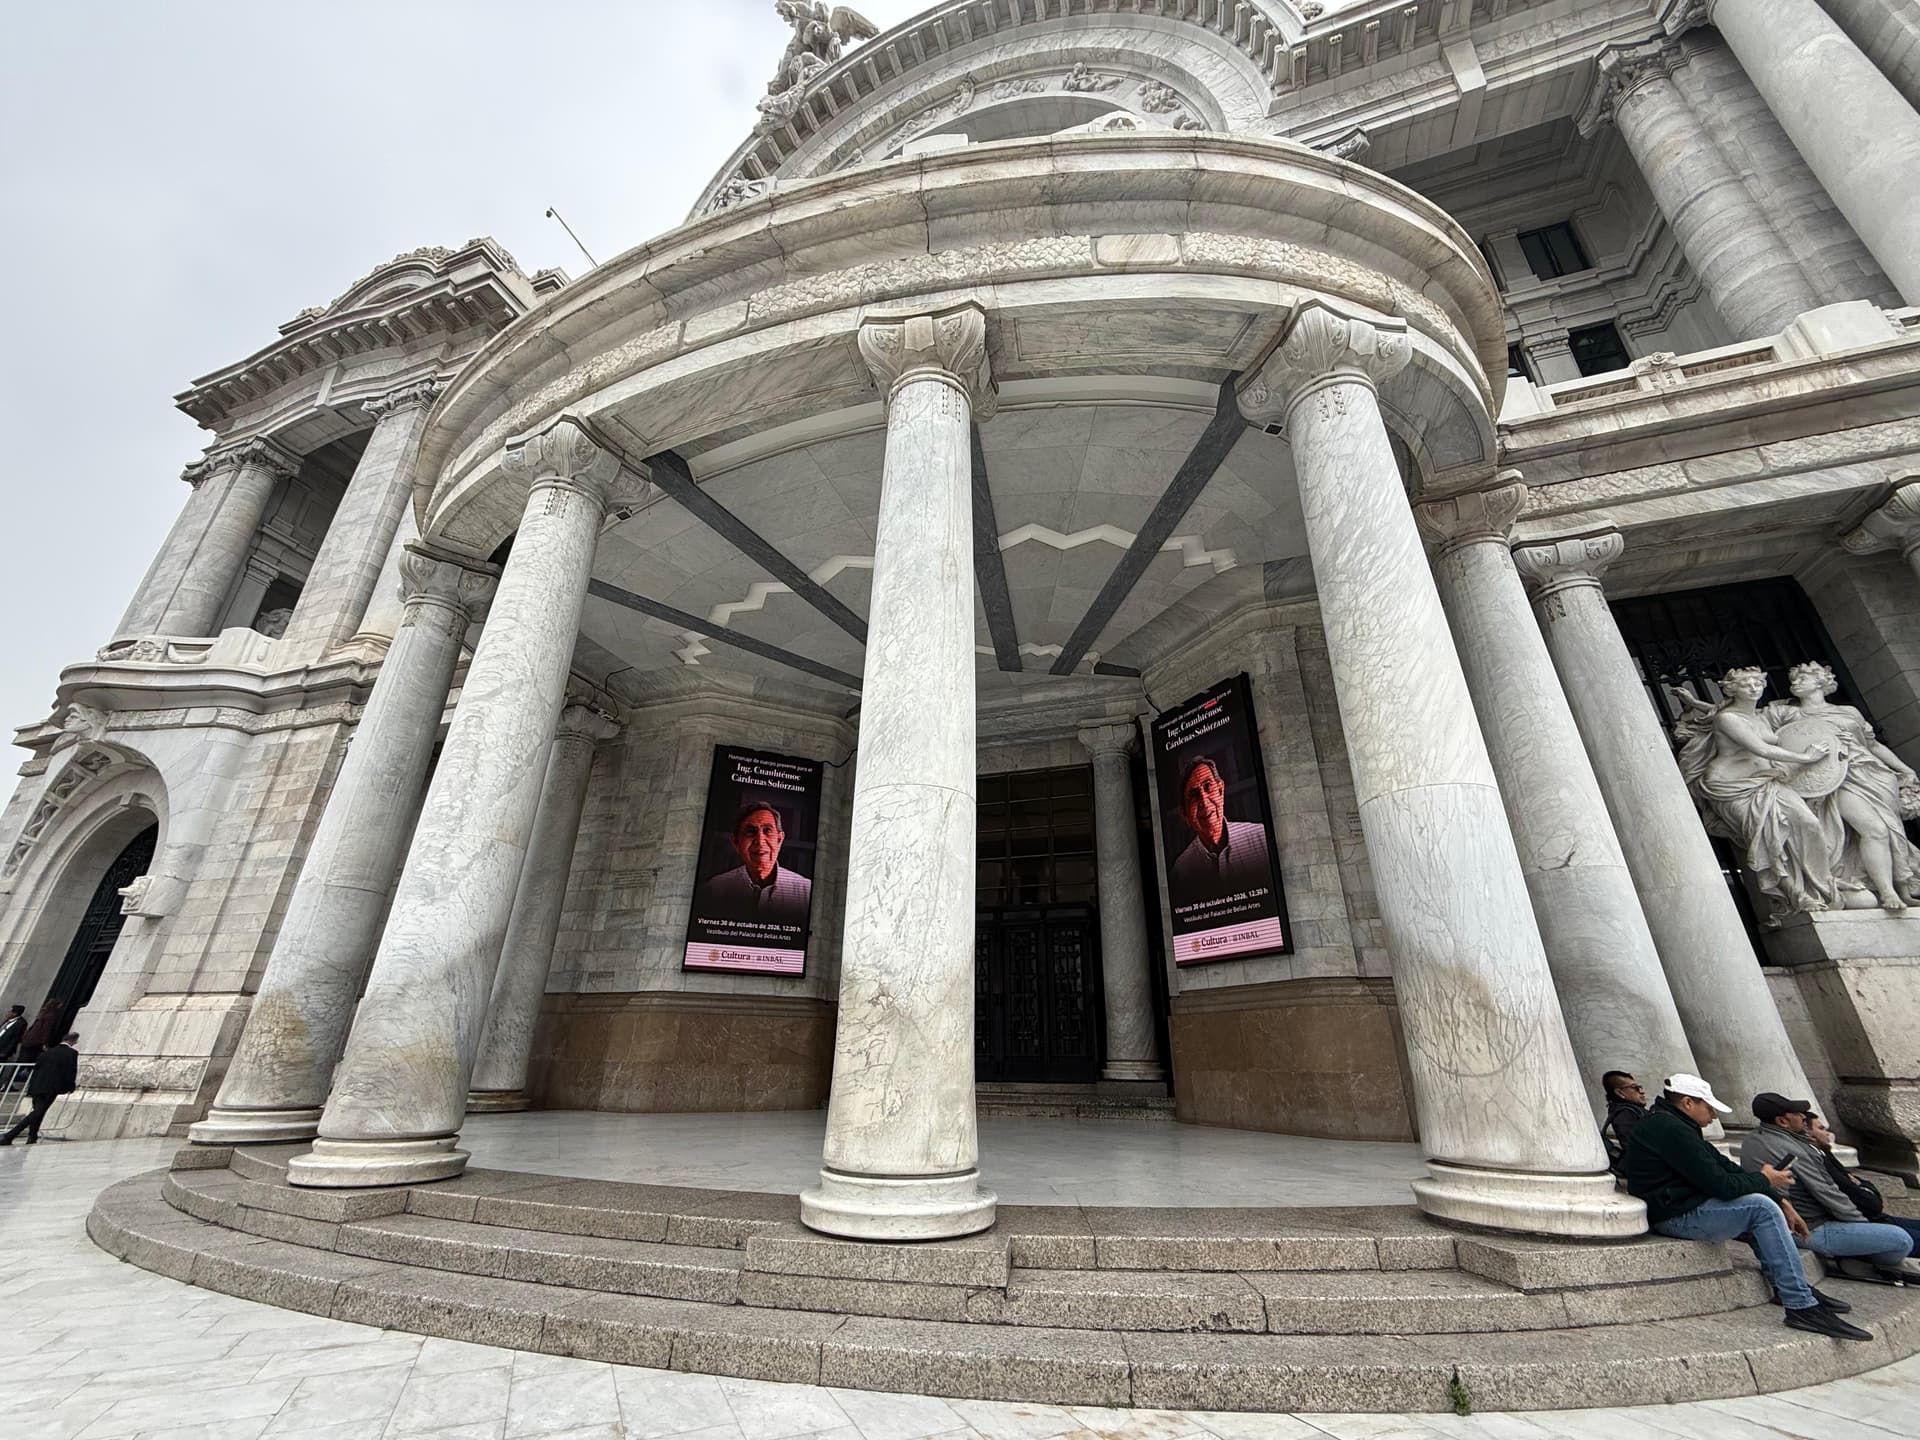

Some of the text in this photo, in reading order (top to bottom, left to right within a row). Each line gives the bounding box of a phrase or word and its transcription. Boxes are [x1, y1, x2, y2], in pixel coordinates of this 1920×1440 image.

[1167, 706, 1223, 738] Ing. Cuauhtémoc
[1166, 716, 1230, 751] Cárdenas Solórzano
[736, 762, 801, 781] Ing. Cuauhtémoc
[731, 773, 805, 792] Cárdenas Solórzano
[1174, 905, 1192, 914] Viernes
[1206, 898, 1226, 908] octubre
[1226, 896, 1233, 904] de
[1201, 931, 1260, 947] Cultura INBAL
[721, 950, 783, 963] Cultura INBAL
